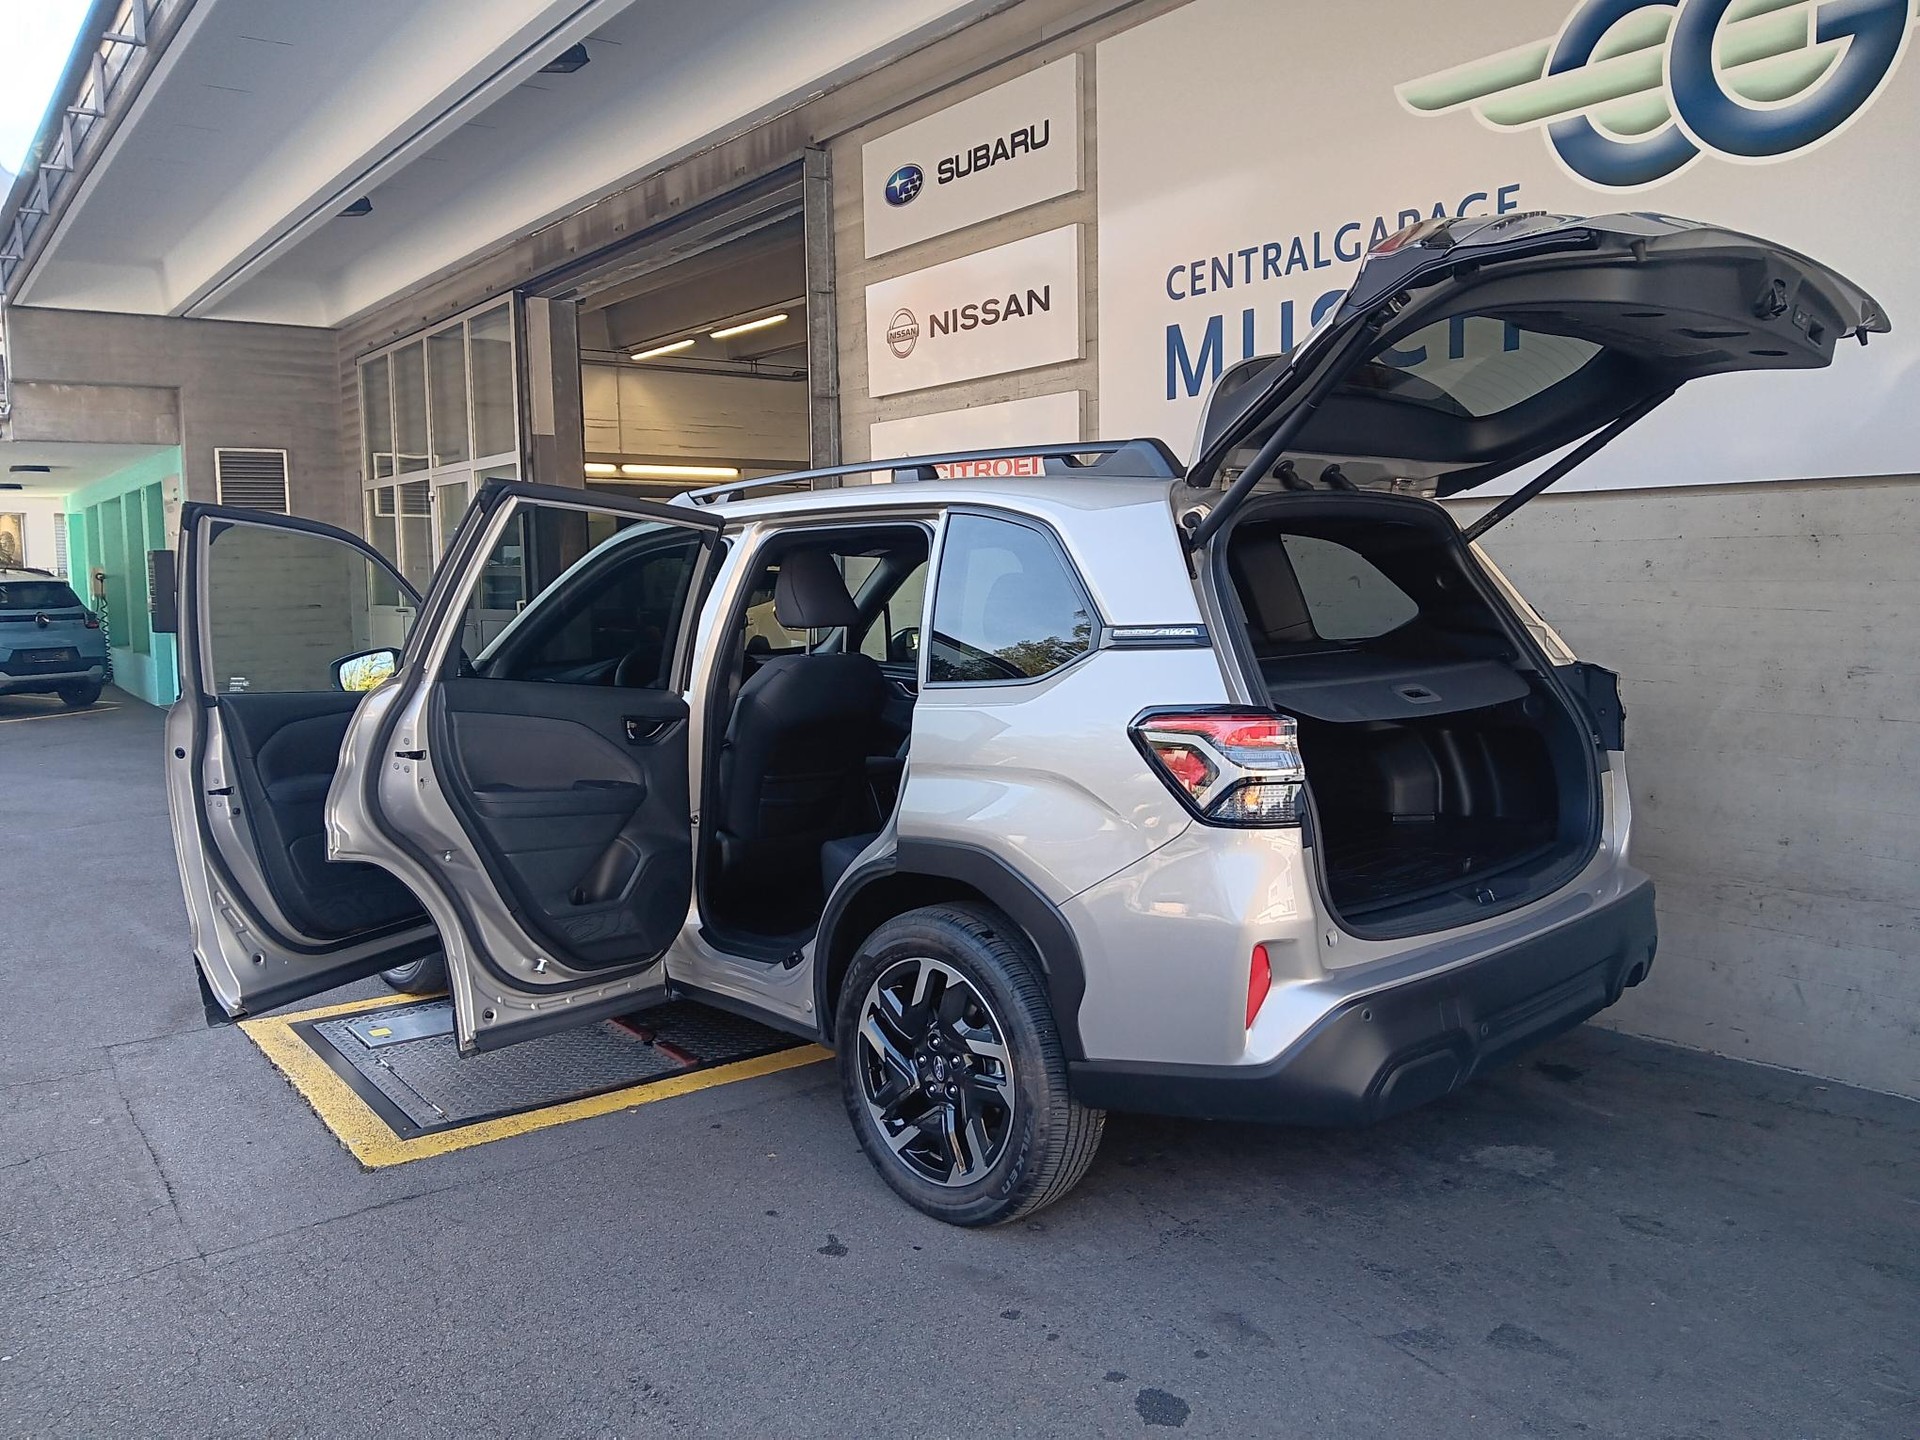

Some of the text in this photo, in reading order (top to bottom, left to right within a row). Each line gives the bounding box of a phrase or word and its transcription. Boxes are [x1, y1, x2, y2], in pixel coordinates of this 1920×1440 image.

[937, 119, 1050, 185] SUBARU
[890, 327, 917, 340] NISSAN
[929, 284, 1050, 339] NISSAN
